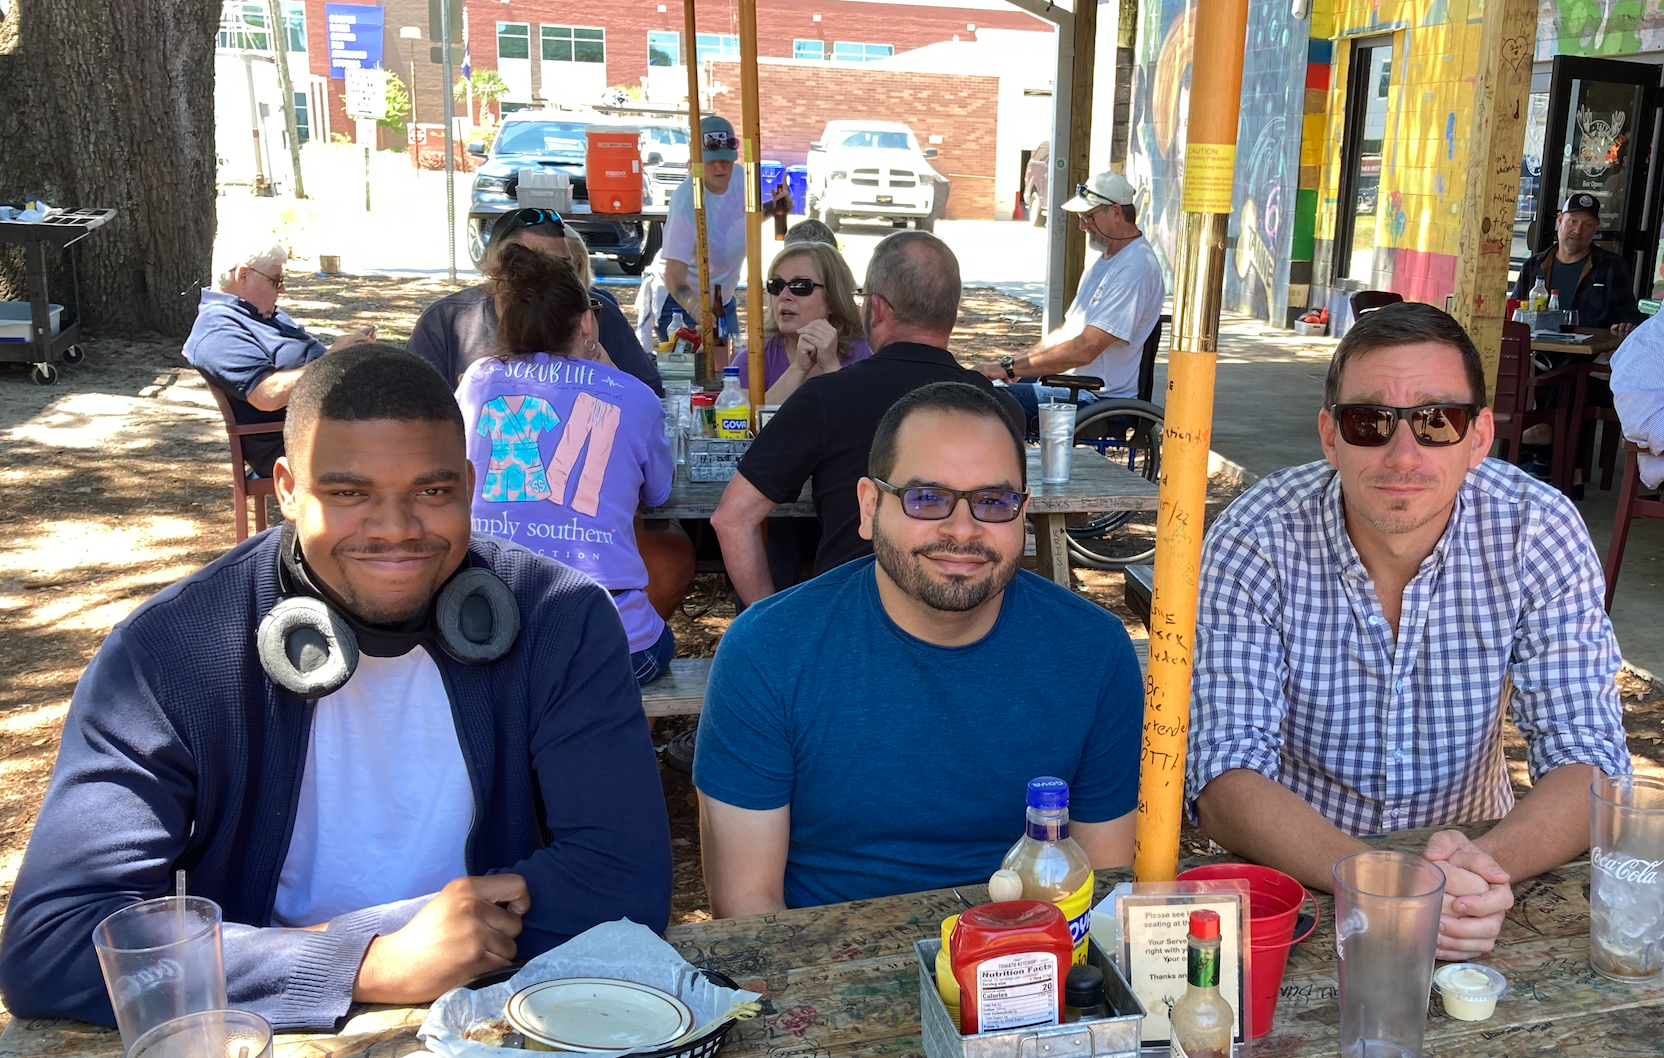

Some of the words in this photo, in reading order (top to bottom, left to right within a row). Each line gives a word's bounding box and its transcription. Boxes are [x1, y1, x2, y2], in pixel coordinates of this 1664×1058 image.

[504, 362, 563, 383] SCRUB
[565, 364, 596, 386] LIFE
[723, 420, 746, 430] GOYA
[472, 511, 520, 542] mply
[526, 517, 614, 544] southern
[538, 549, 600, 560] CTION
[1053, 530, 1062, 566] KRIS
[1591, 846, 1664, 884] Coca-Cola
[1144, 920, 1172, 928] seating
[982, 969, 1024, 978] Nutrition
[1028, 964, 1052, 973] Facts
[1042, 982, 1052, 990] 20
